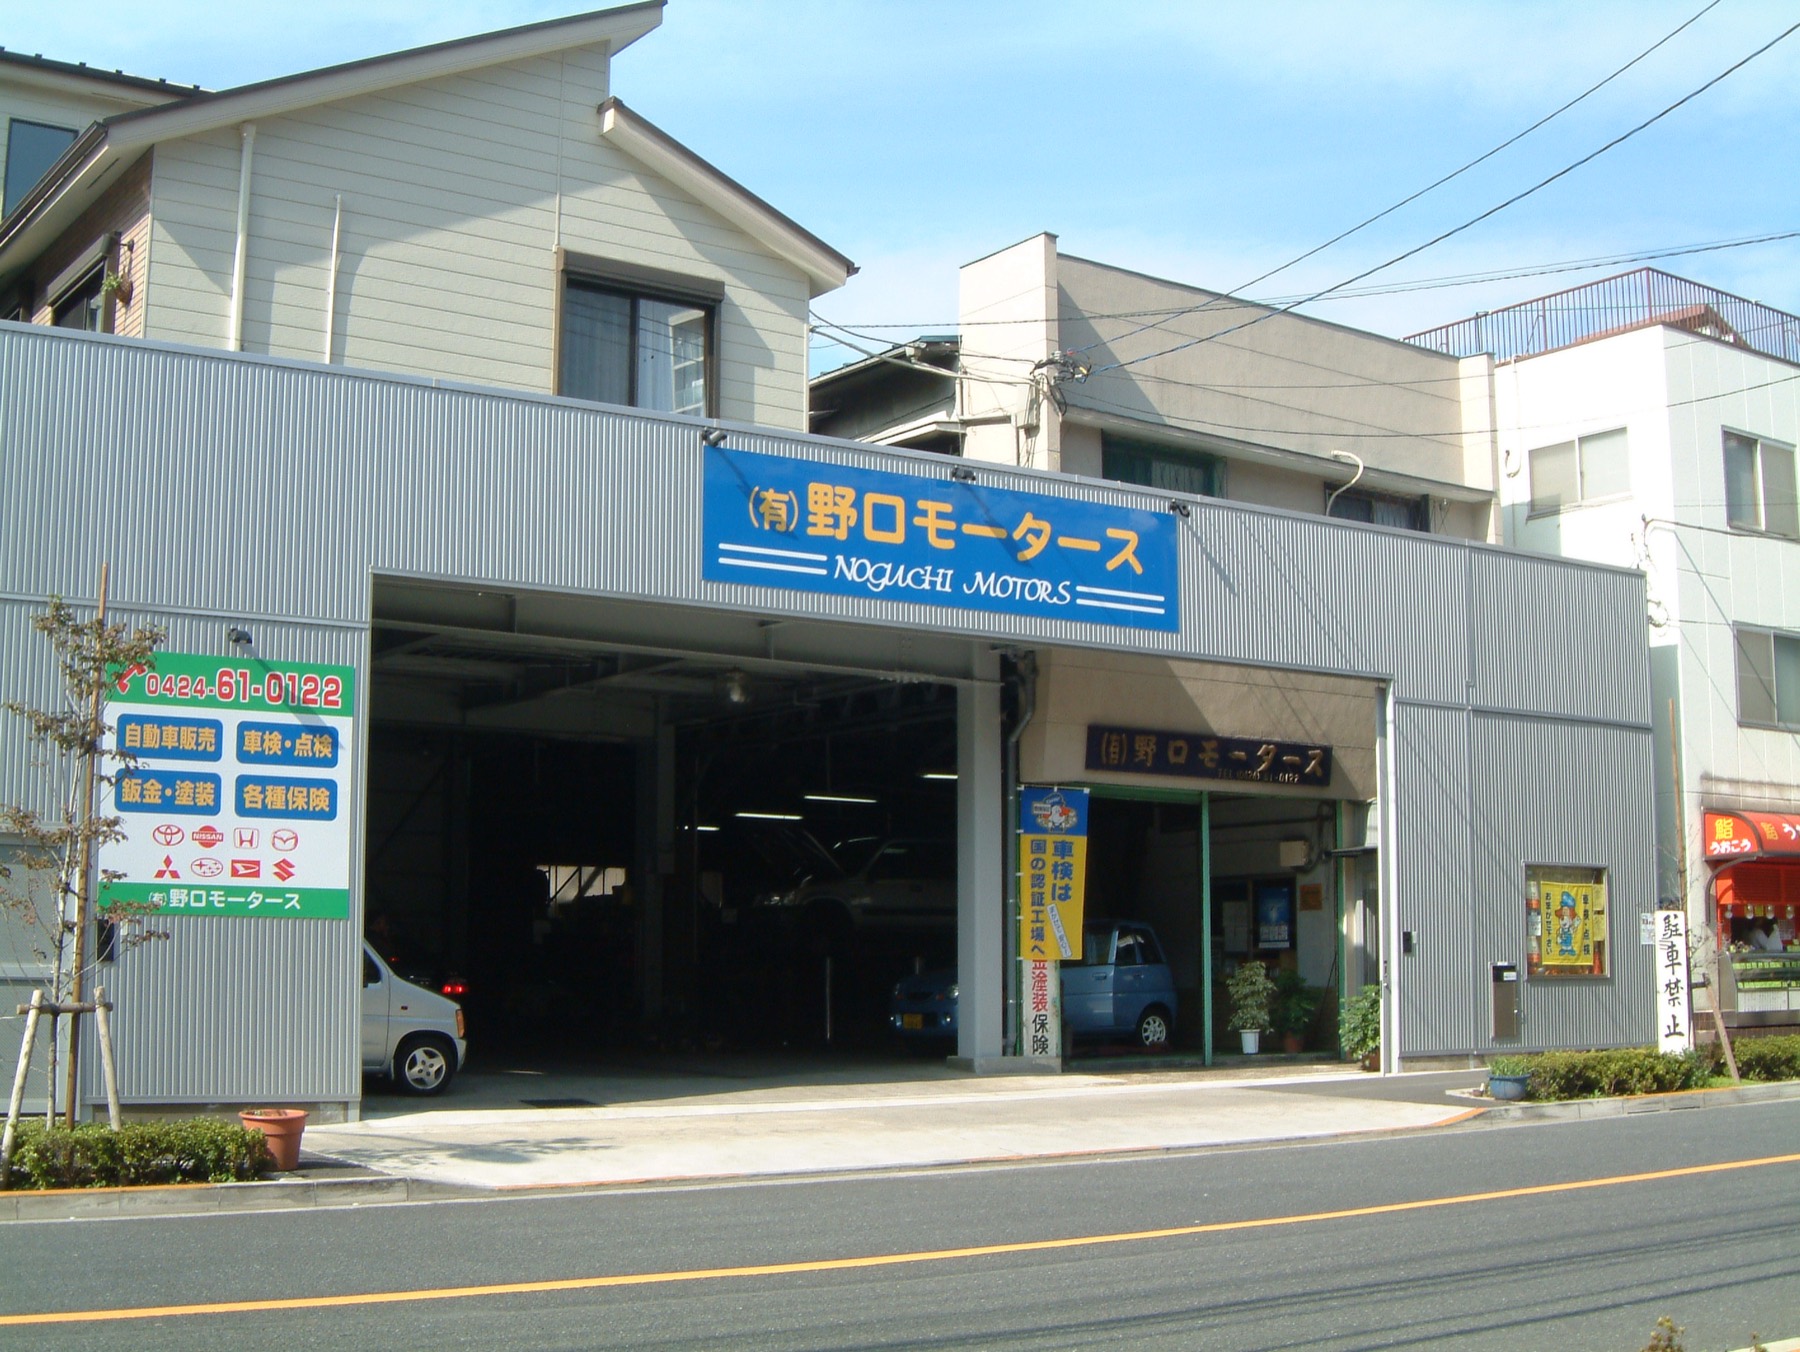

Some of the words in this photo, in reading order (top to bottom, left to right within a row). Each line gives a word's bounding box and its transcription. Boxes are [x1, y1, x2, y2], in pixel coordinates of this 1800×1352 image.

[963, 570, 1072, 605] MOTORS
[146, 667, 342, 708] 0424-61-0122
[124, 722, 216, 752] 自動車販売
[243, 729, 333, 759] 車検・点検
[121, 777, 215, 807] 鈑金・塗装
[242, 783, 330, 812] 各種保険
[193, 832, 222, 841] NISSAN
[1715, 818, 1733, 840] 鮨
[1782, 822, 1800, 840] う
[1709, 838, 1751, 855] うおこう
[1051, 839, 1074, 902] 車検は
[1030, 839, 1047, 955] 国の認証工場へ
[1662, 913, 1685, 1038] 駐車禁止
